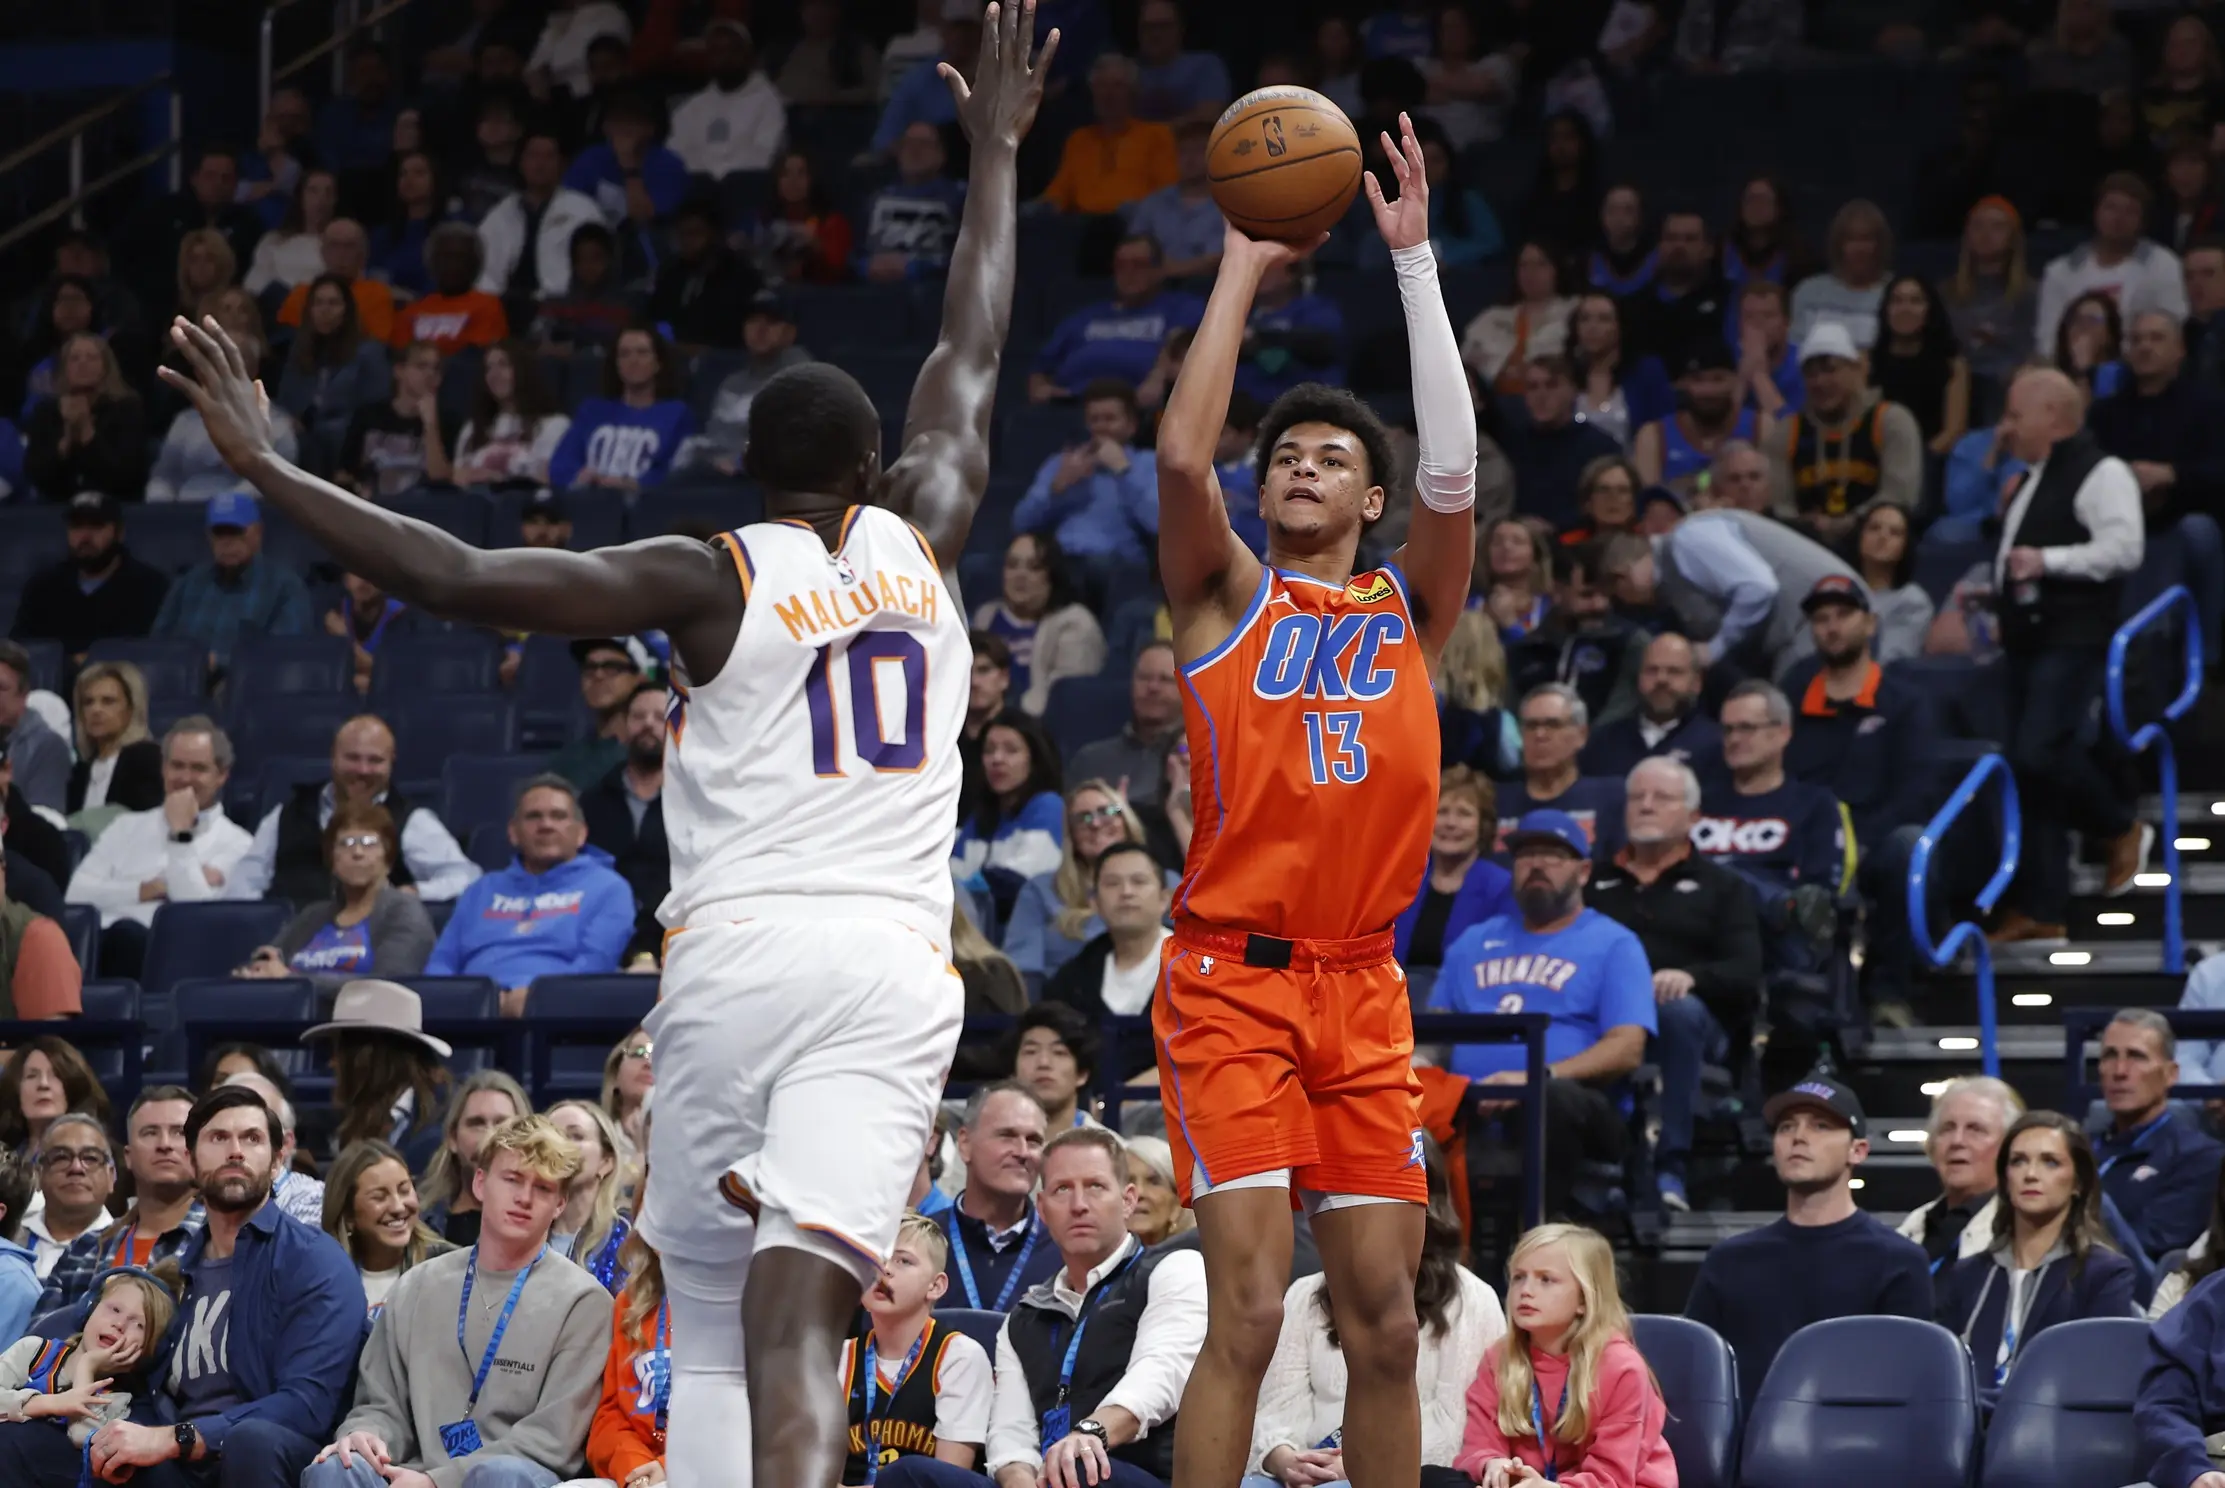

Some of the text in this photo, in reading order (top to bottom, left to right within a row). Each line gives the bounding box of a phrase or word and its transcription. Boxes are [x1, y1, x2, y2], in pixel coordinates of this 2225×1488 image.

[773, 570, 937, 642] MALUACH
[1253, 612, 1406, 701] OKC
[805, 631, 929, 779] 10
[1302, 710, 1369, 785] 13
[1473, 953, 1578, 991] THUNDER
